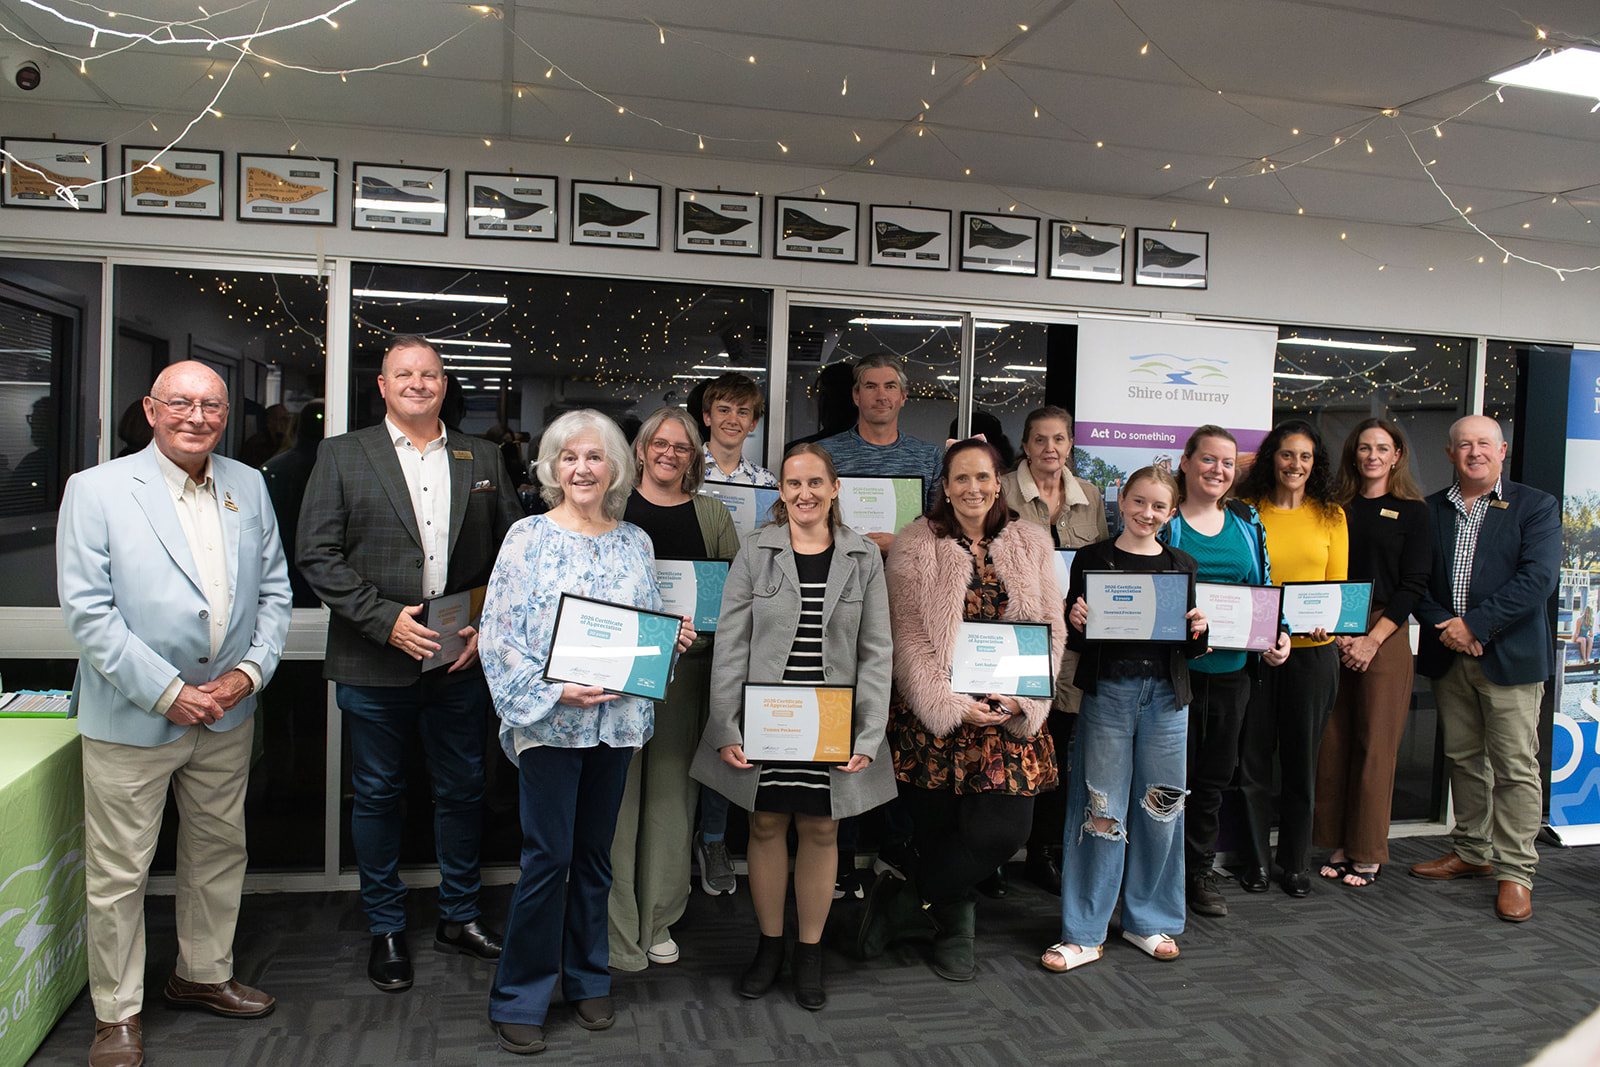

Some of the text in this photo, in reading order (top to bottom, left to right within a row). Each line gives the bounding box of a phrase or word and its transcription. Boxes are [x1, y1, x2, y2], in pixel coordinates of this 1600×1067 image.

[1128, 386, 1229, 405] Shire of Murray
[1091, 428, 1176, 444] Act Do something
[586, 621, 621, 631] Appreciation
[595, 617, 623, 627] Certificate
[12, 969, 32, 1021] of
